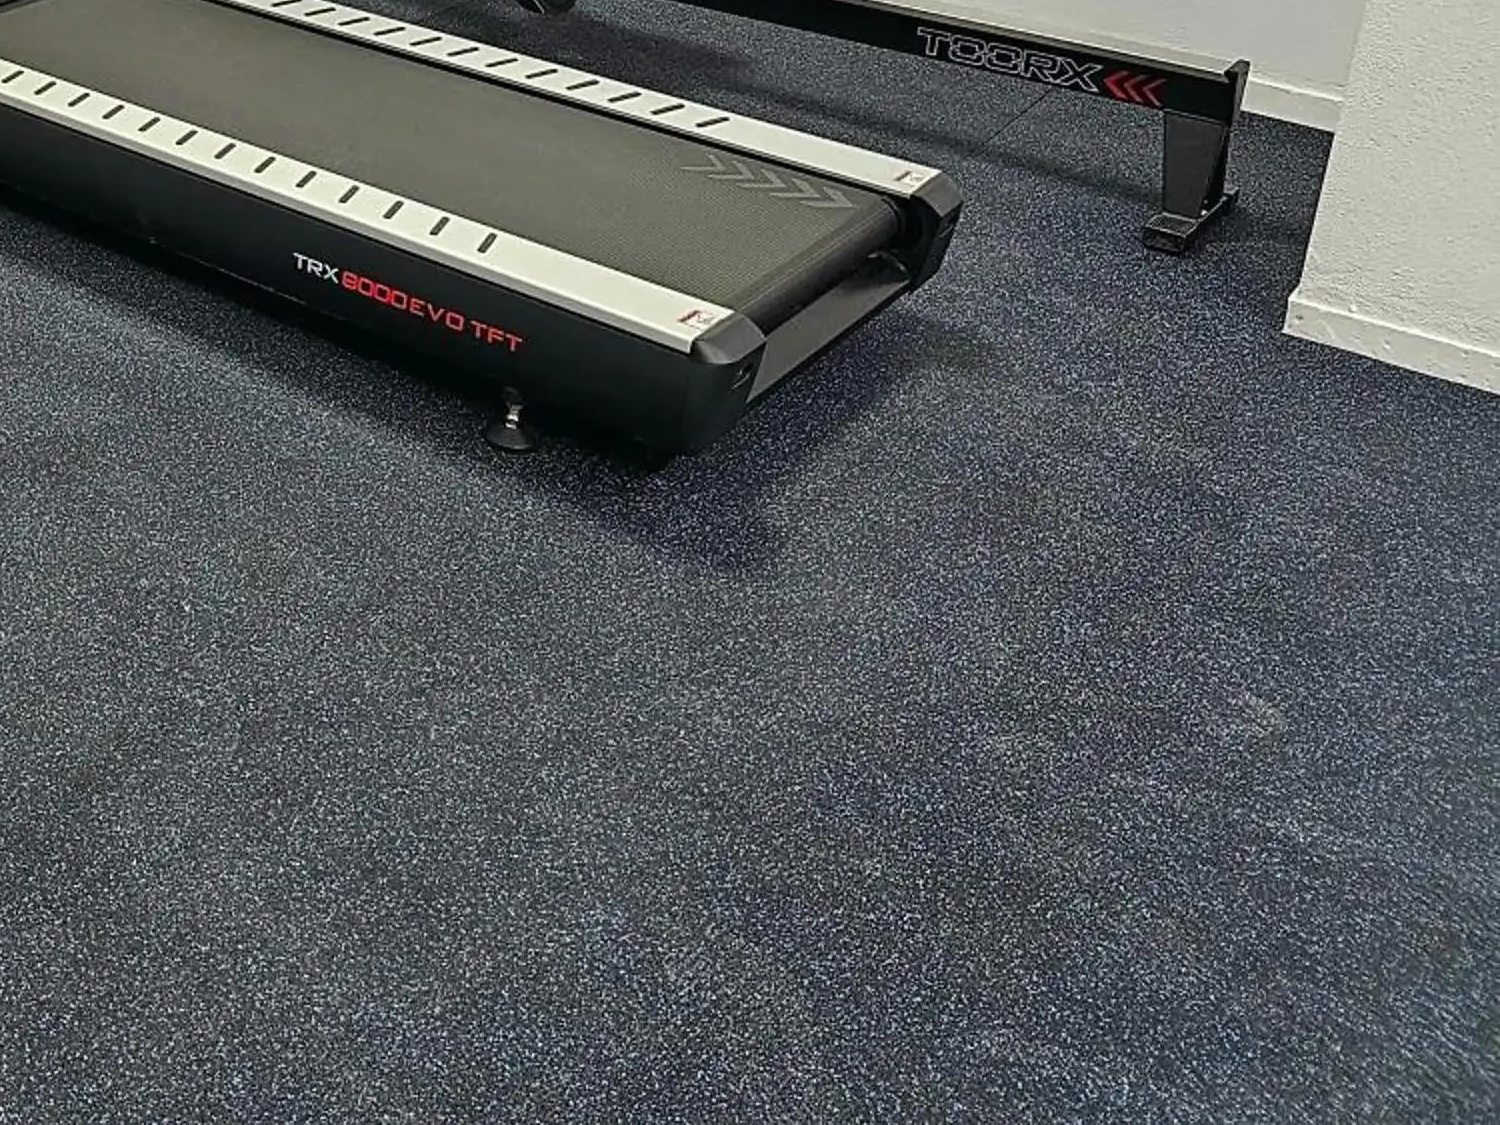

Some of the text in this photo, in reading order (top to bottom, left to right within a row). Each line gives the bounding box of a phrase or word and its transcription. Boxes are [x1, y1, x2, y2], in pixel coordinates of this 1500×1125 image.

[917, 26, 1103, 93] TOORX
[293, 252, 339, 284] TRX
[470, 320, 523, 352] TFT
